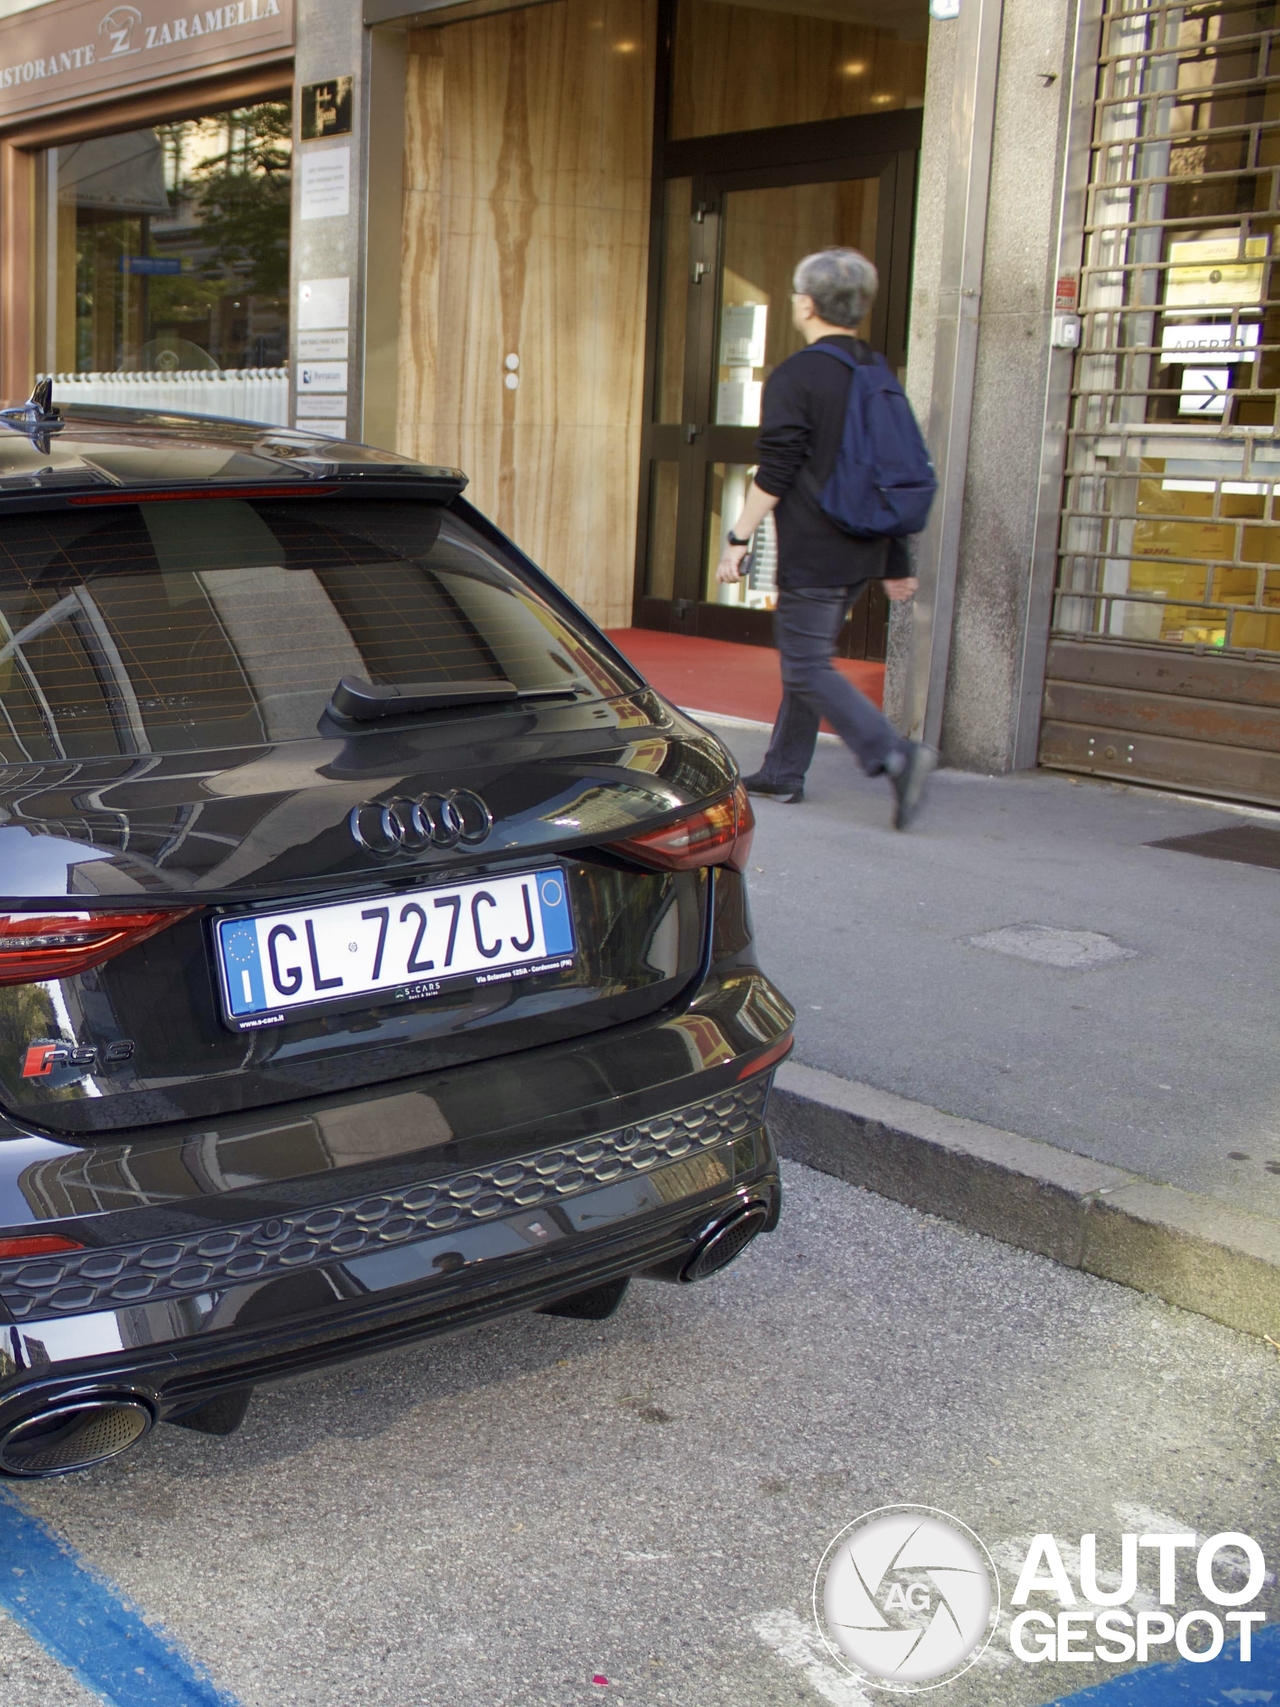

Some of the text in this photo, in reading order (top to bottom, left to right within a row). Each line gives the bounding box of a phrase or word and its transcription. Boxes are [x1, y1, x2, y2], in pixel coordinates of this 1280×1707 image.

[145, 0, 280, 49] ZARAMELLA
[1173, 338, 1245, 354] APERTO
[267, 883, 536, 995] GL 727CJ
[476, 975, 487, 984] Via
[487, 971, 512, 981] Sclavons
[531, 962, 560, 973] Cordenons
[560, 959, 573, 968] (PN)
[404, 982, 441, 996] S-CARS
[239, 1014, 285, 1029] www.s-cars.it
[40, 1040, 135, 1071] RS 3
